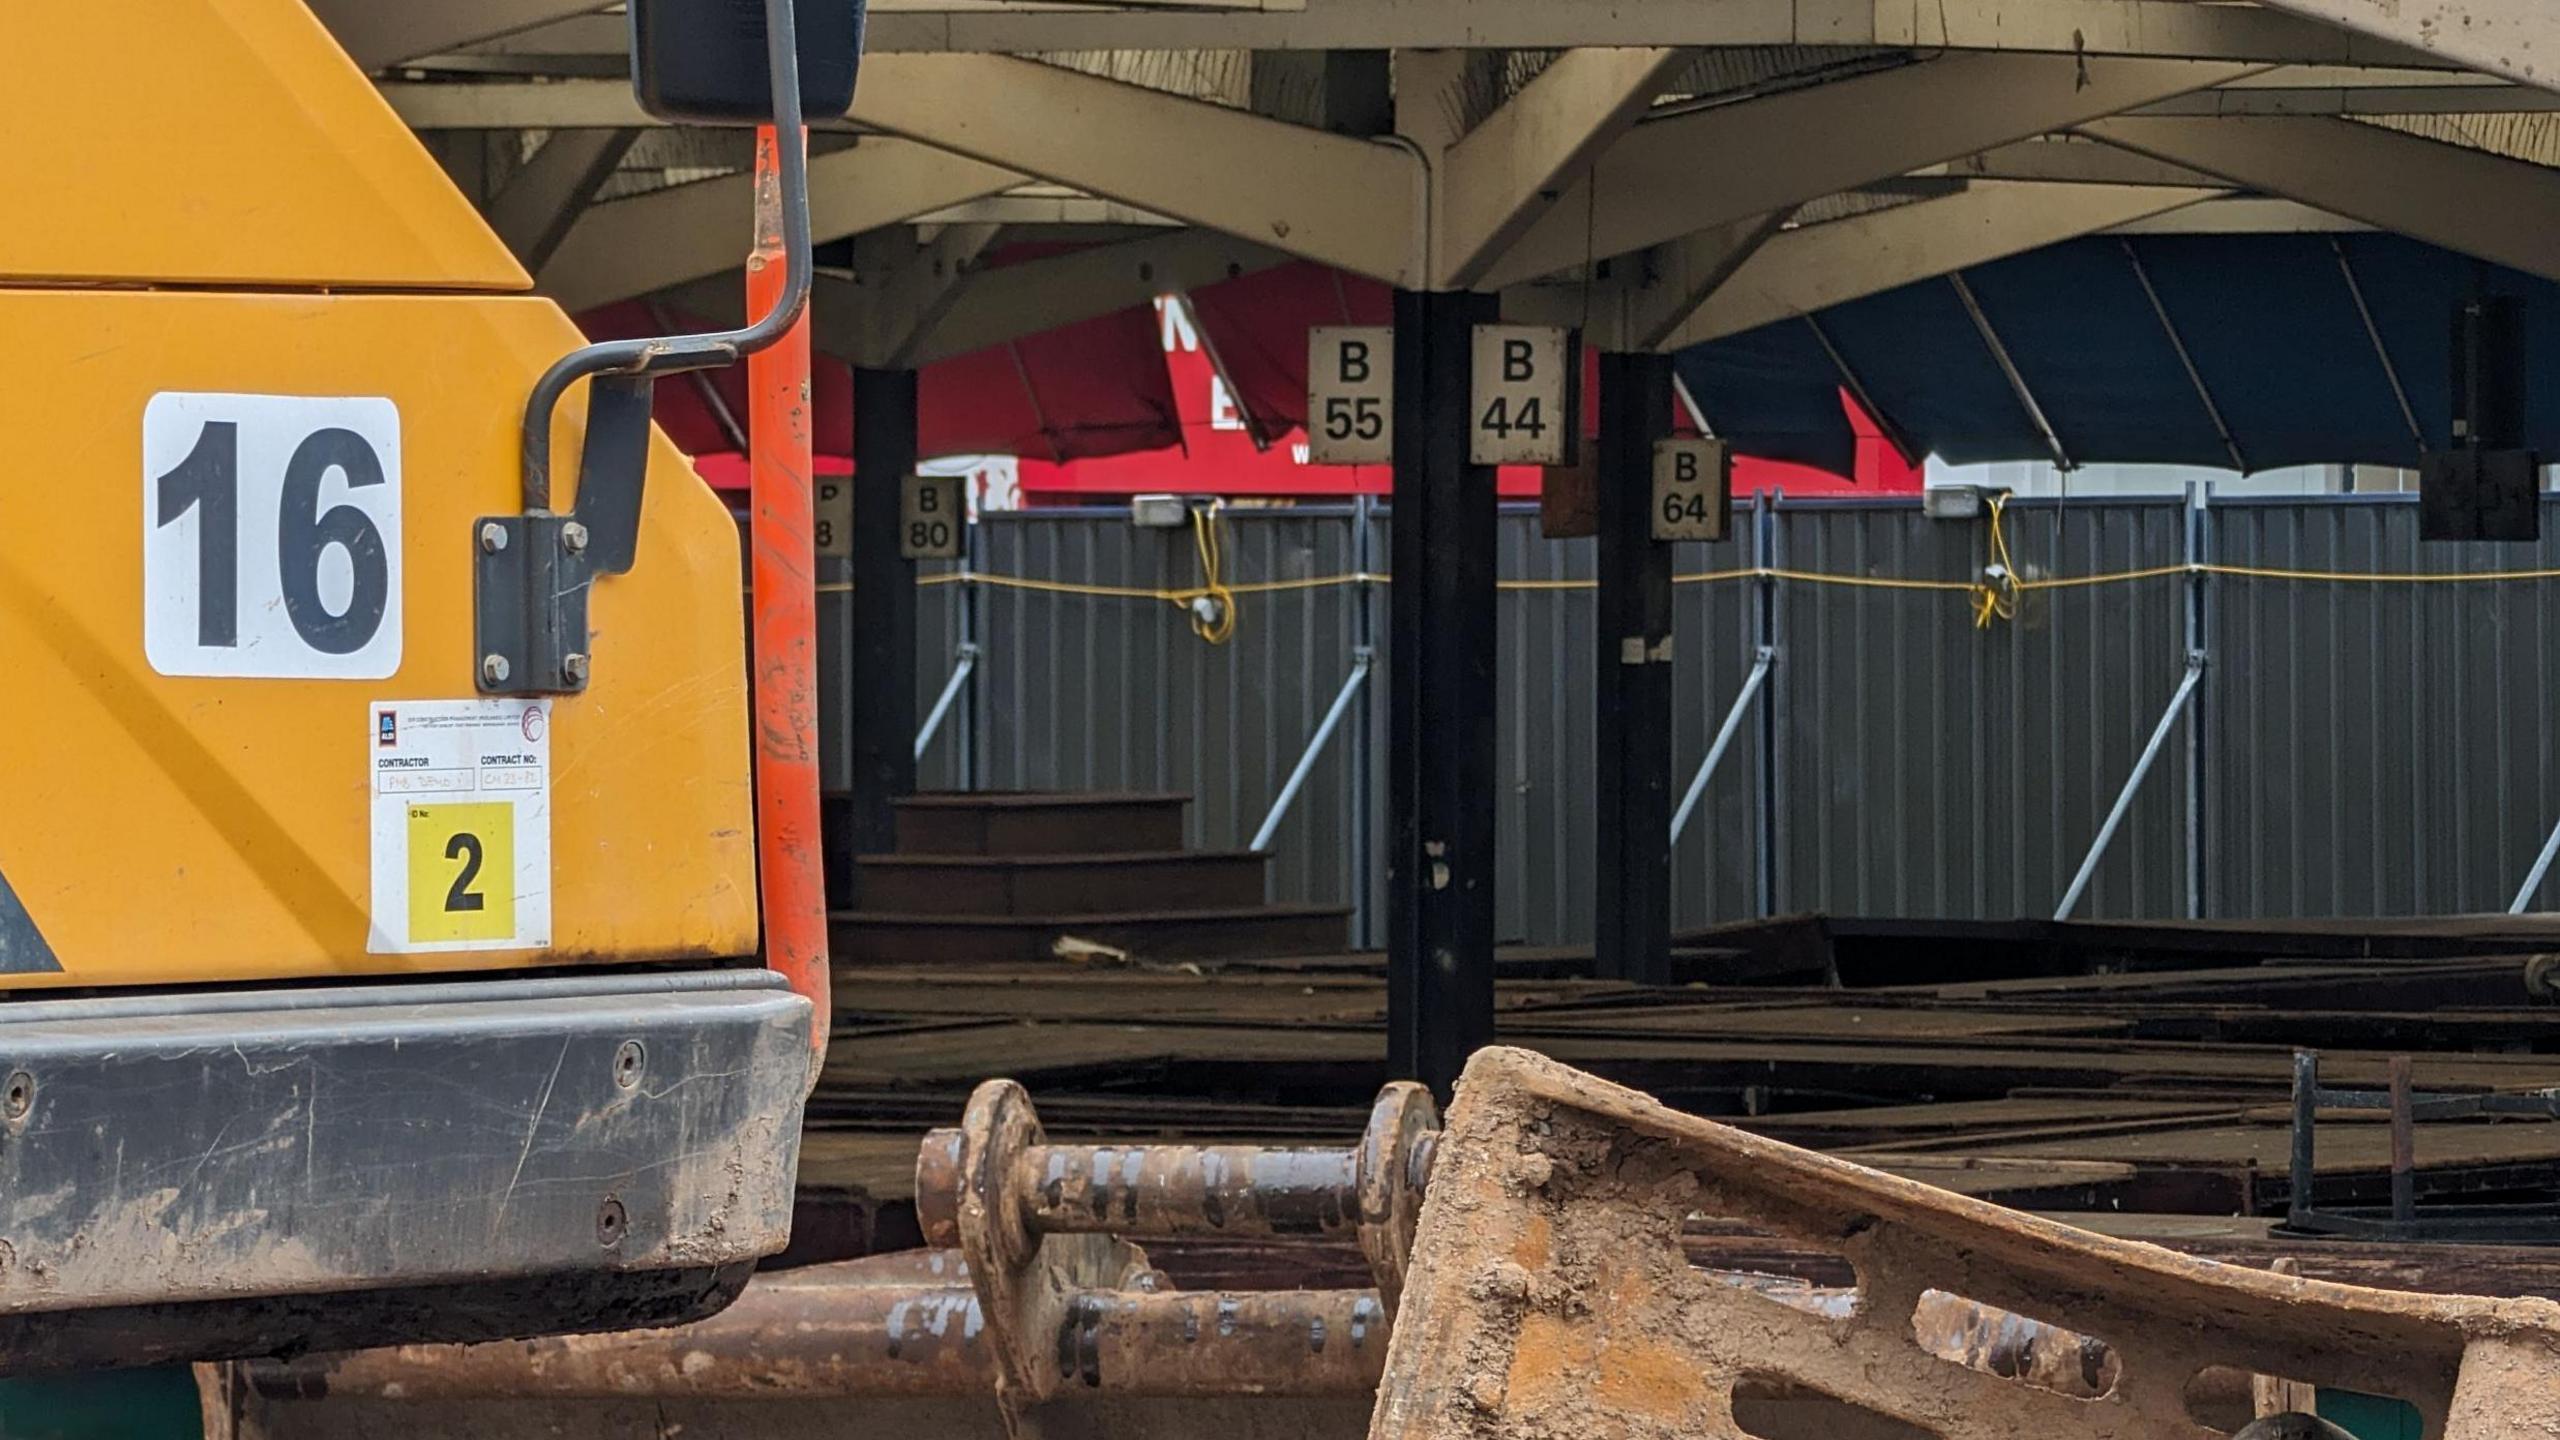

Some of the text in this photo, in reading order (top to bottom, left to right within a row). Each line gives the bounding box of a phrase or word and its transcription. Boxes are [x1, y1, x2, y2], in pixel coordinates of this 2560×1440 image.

[1339, 340, 1370, 383] B
[1503, 340, 1534, 382] B
[1325, 397, 1383, 440] 55
[1480, 397, 1546, 439] 44
[1675, 452, 1698, 482] B
[919, 487, 939, 513] B
[1663, 492, 1708, 524] 64
[157, 420, 389, 655] 16
[910, 522, 949, 548] 80
[378, 758, 429, 768] CONTRACTOR
[481, 754, 537, 765] CONTRACT NO:
[444, 832, 484, 913] 2
